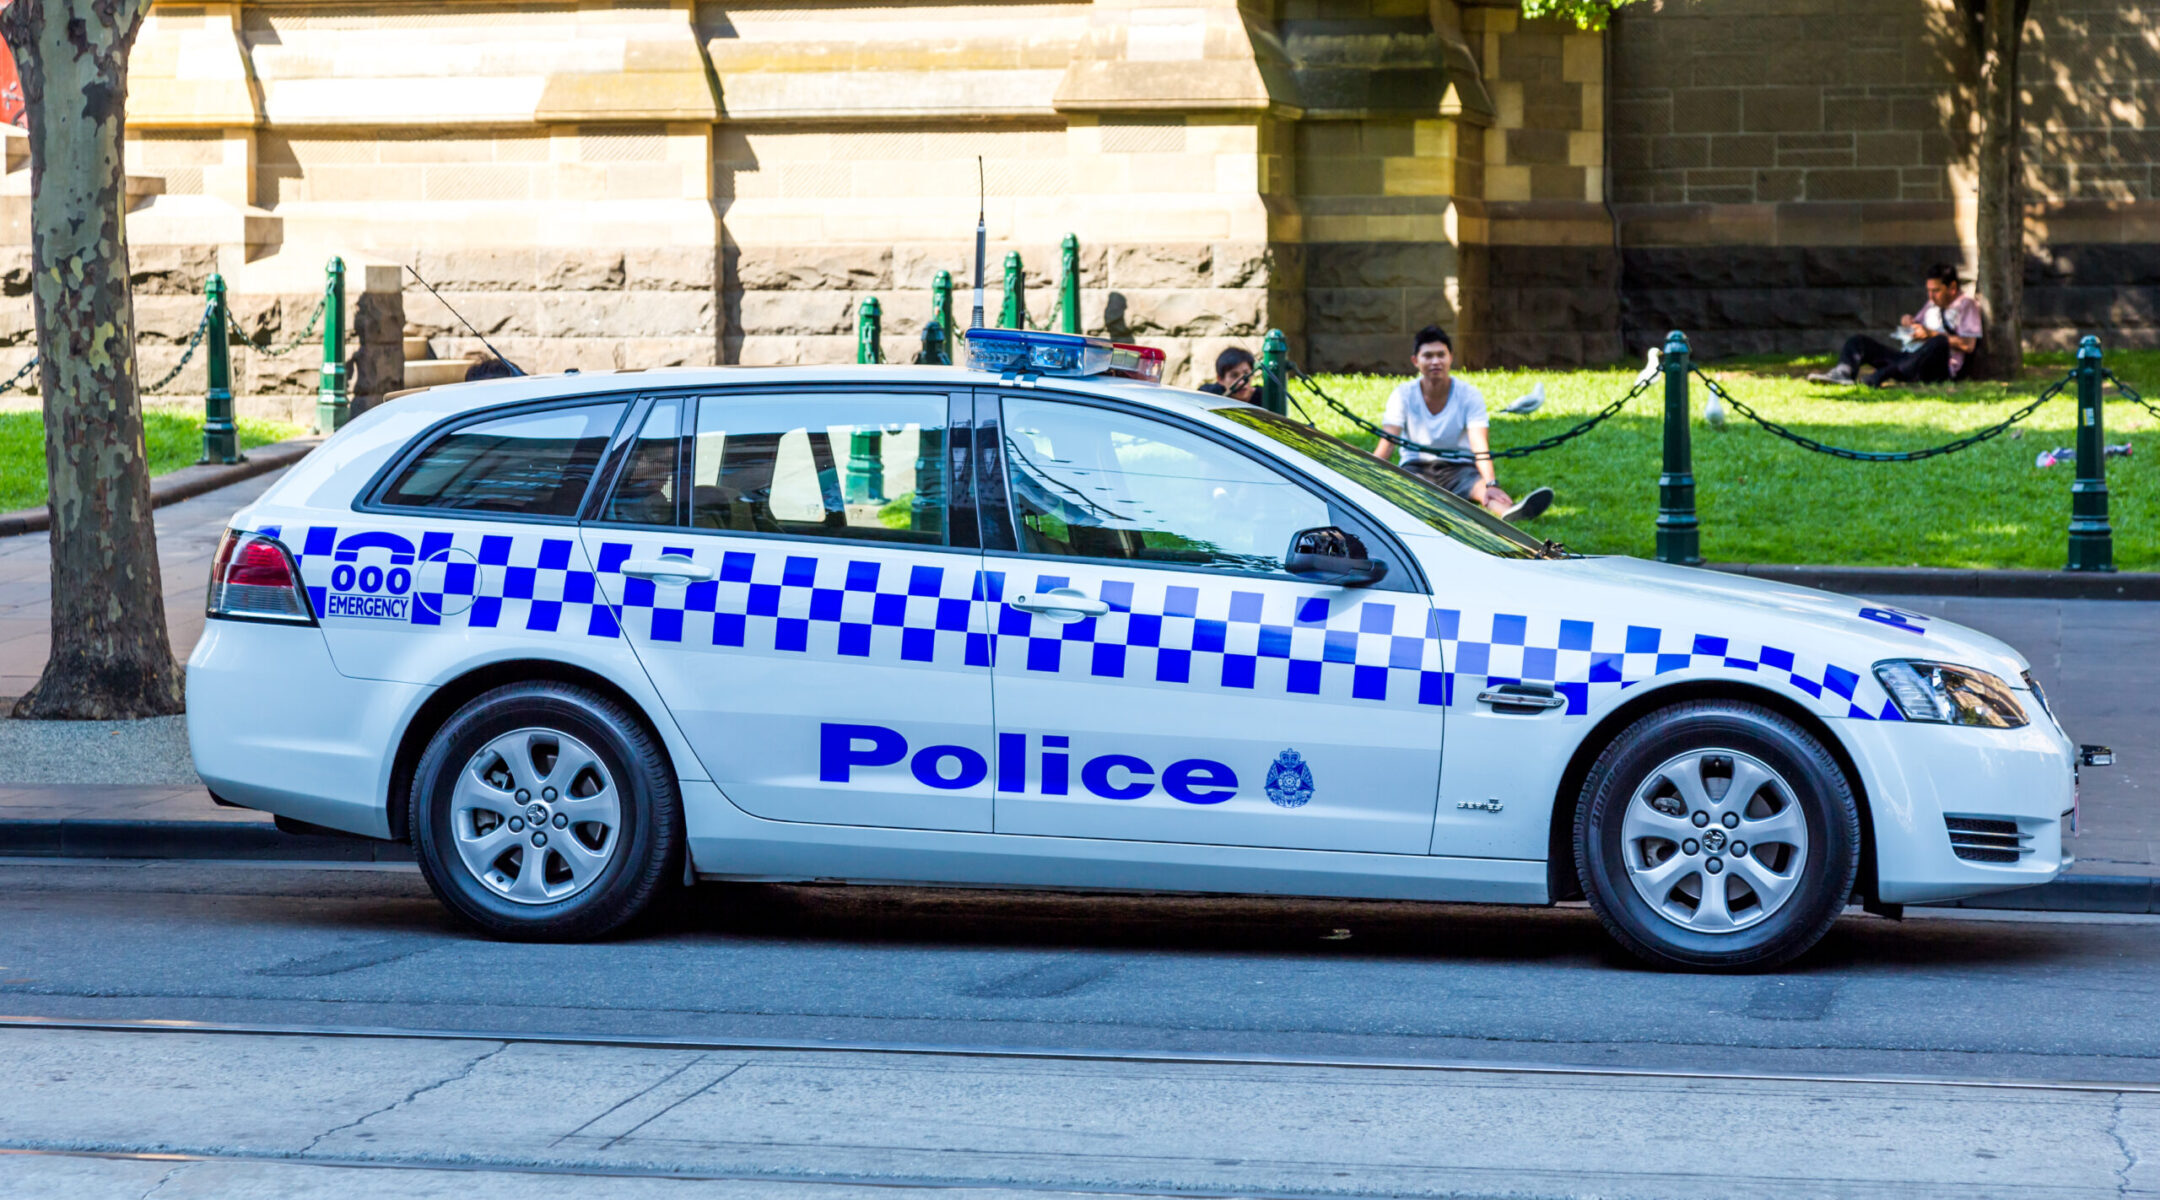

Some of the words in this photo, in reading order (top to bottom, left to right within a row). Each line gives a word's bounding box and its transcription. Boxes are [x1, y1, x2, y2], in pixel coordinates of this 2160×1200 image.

[331, 564, 411, 595] 000
[328, 595, 409, 618] EMERGENCY
[820, 722, 1239, 805] Police
